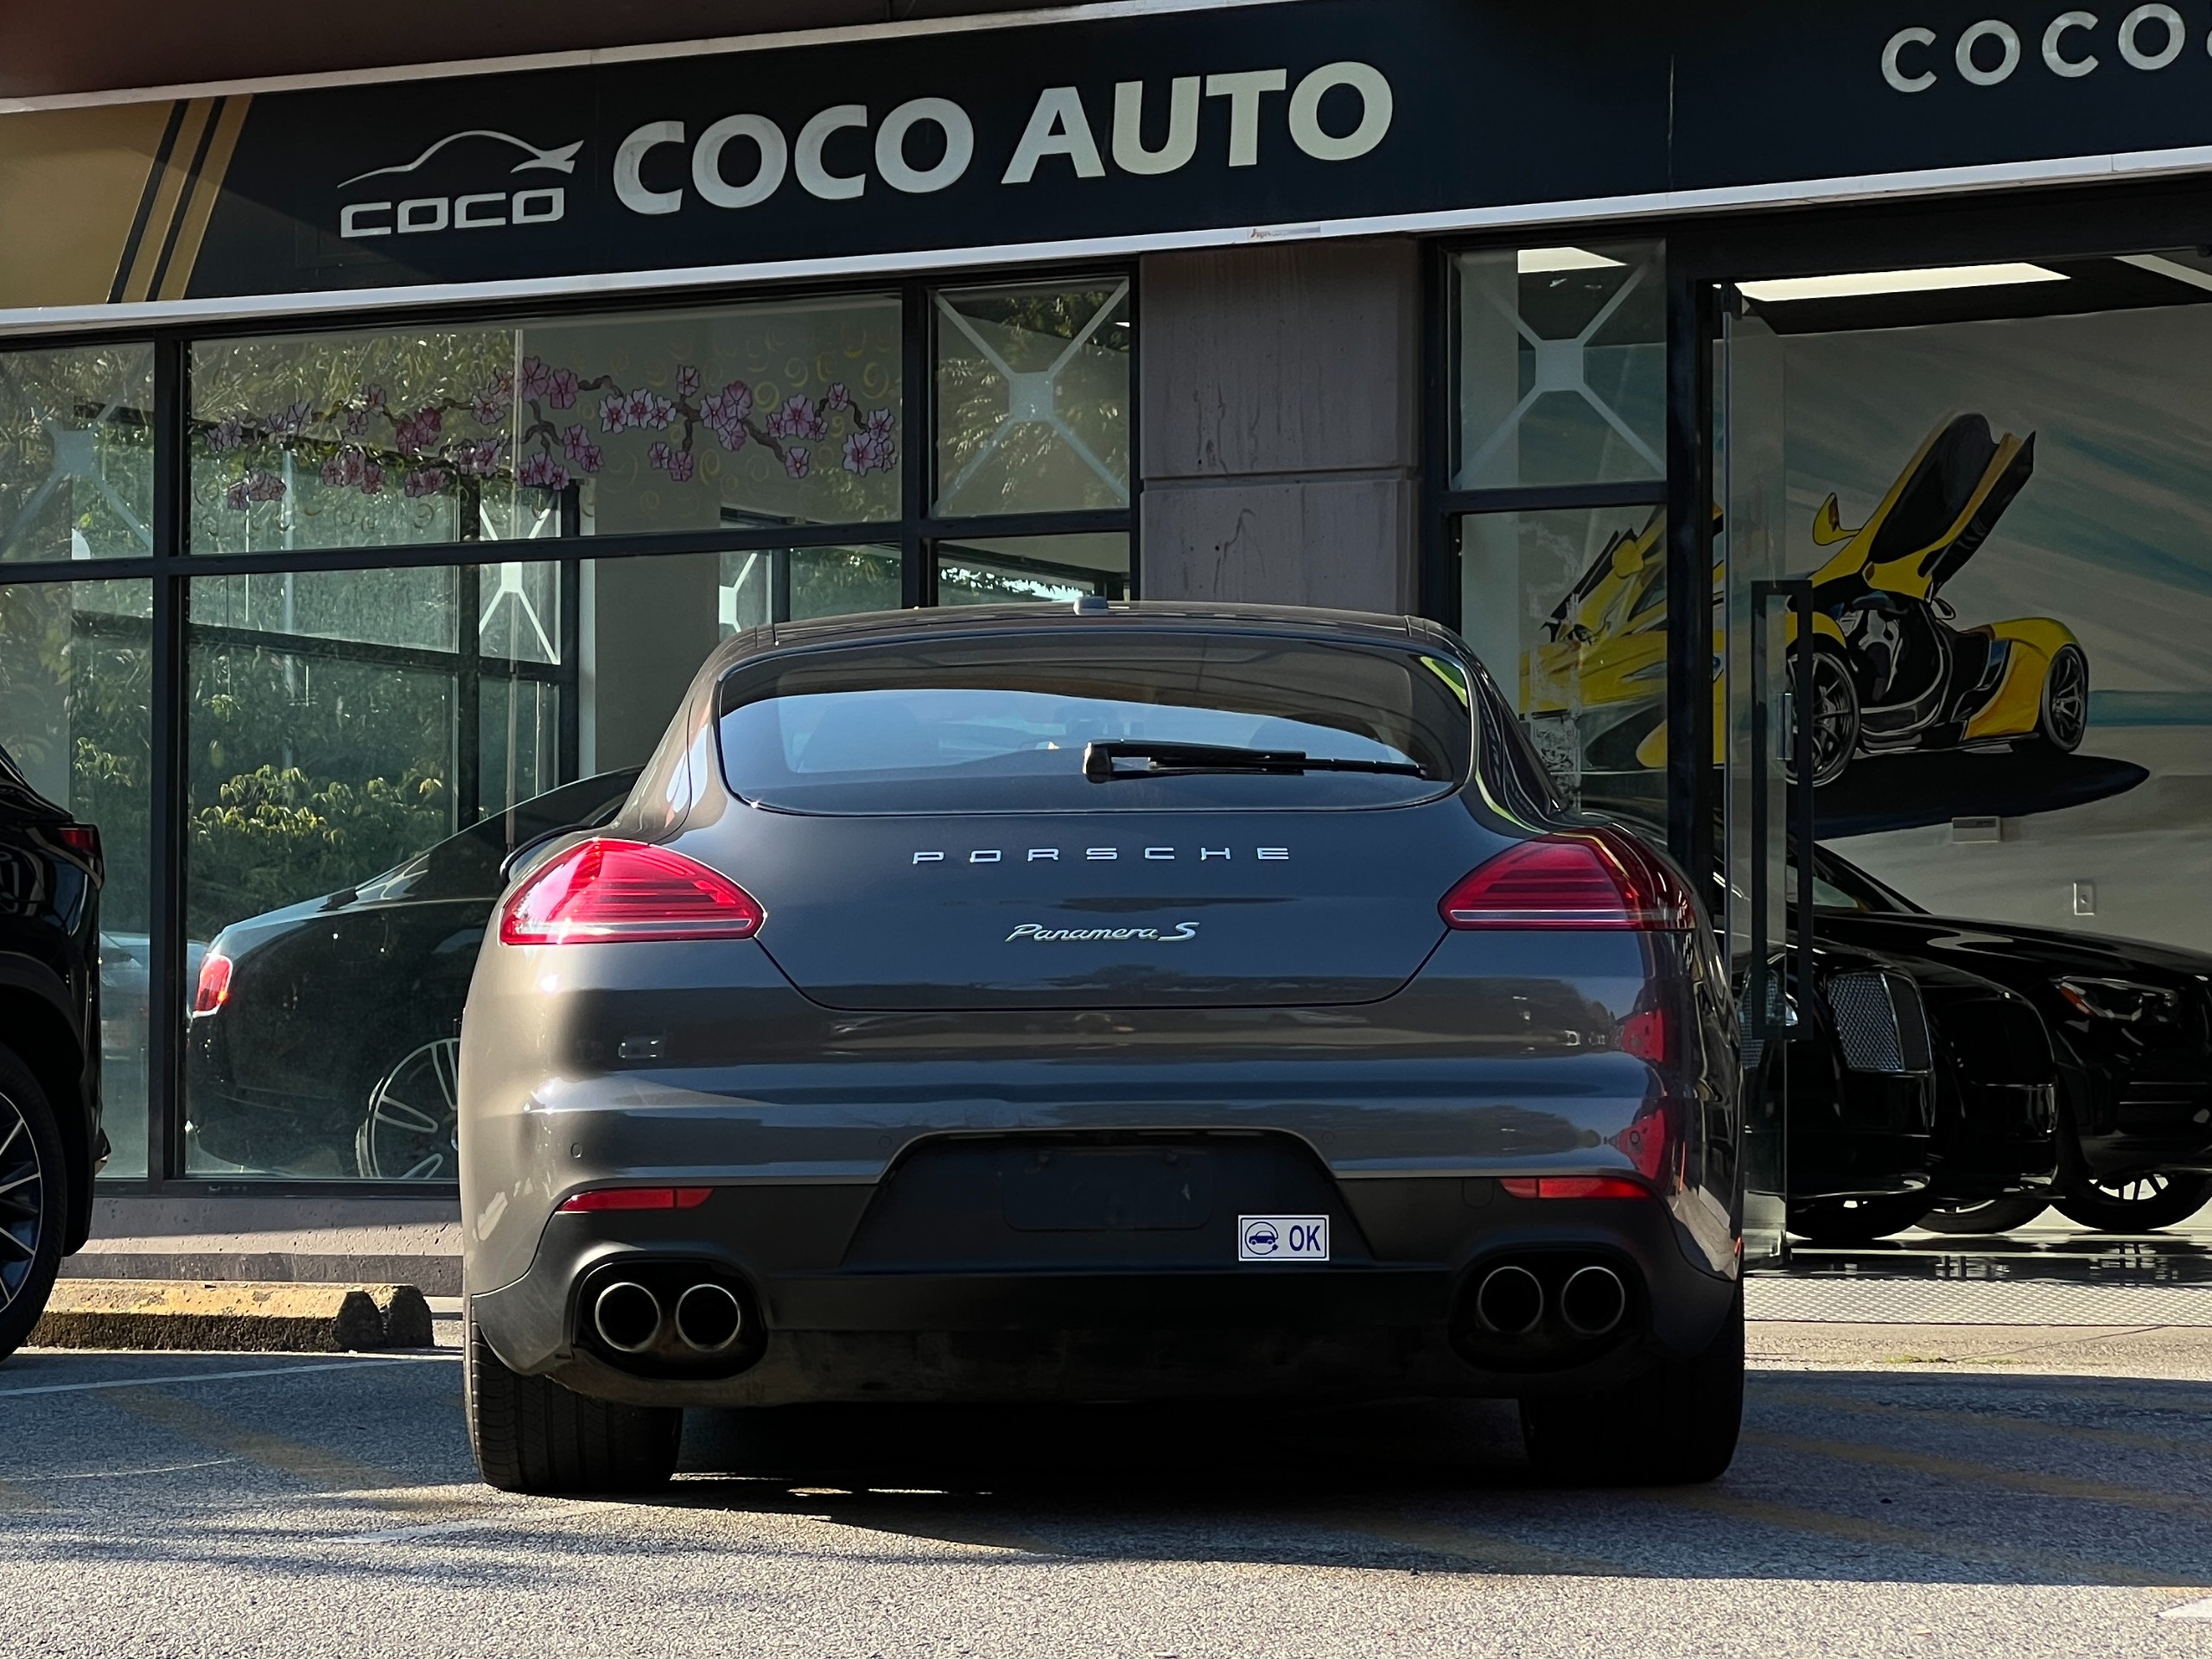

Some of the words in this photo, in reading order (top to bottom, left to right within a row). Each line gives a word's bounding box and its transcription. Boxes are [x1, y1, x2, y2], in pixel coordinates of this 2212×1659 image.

[1881, 3, 2212, 93] COCO
[613, 97, 974, 214] COCO
[1001, 61, 1393, 184] AUTO
[340, 188, 564, 238] COCO
[912, 847, 1289, 865] PORSCHE
[1005, 923, 1159, 943] Panamera
[1158, 921, 1200, 942] S
[1288, 1224, 1321, 1252] OK
